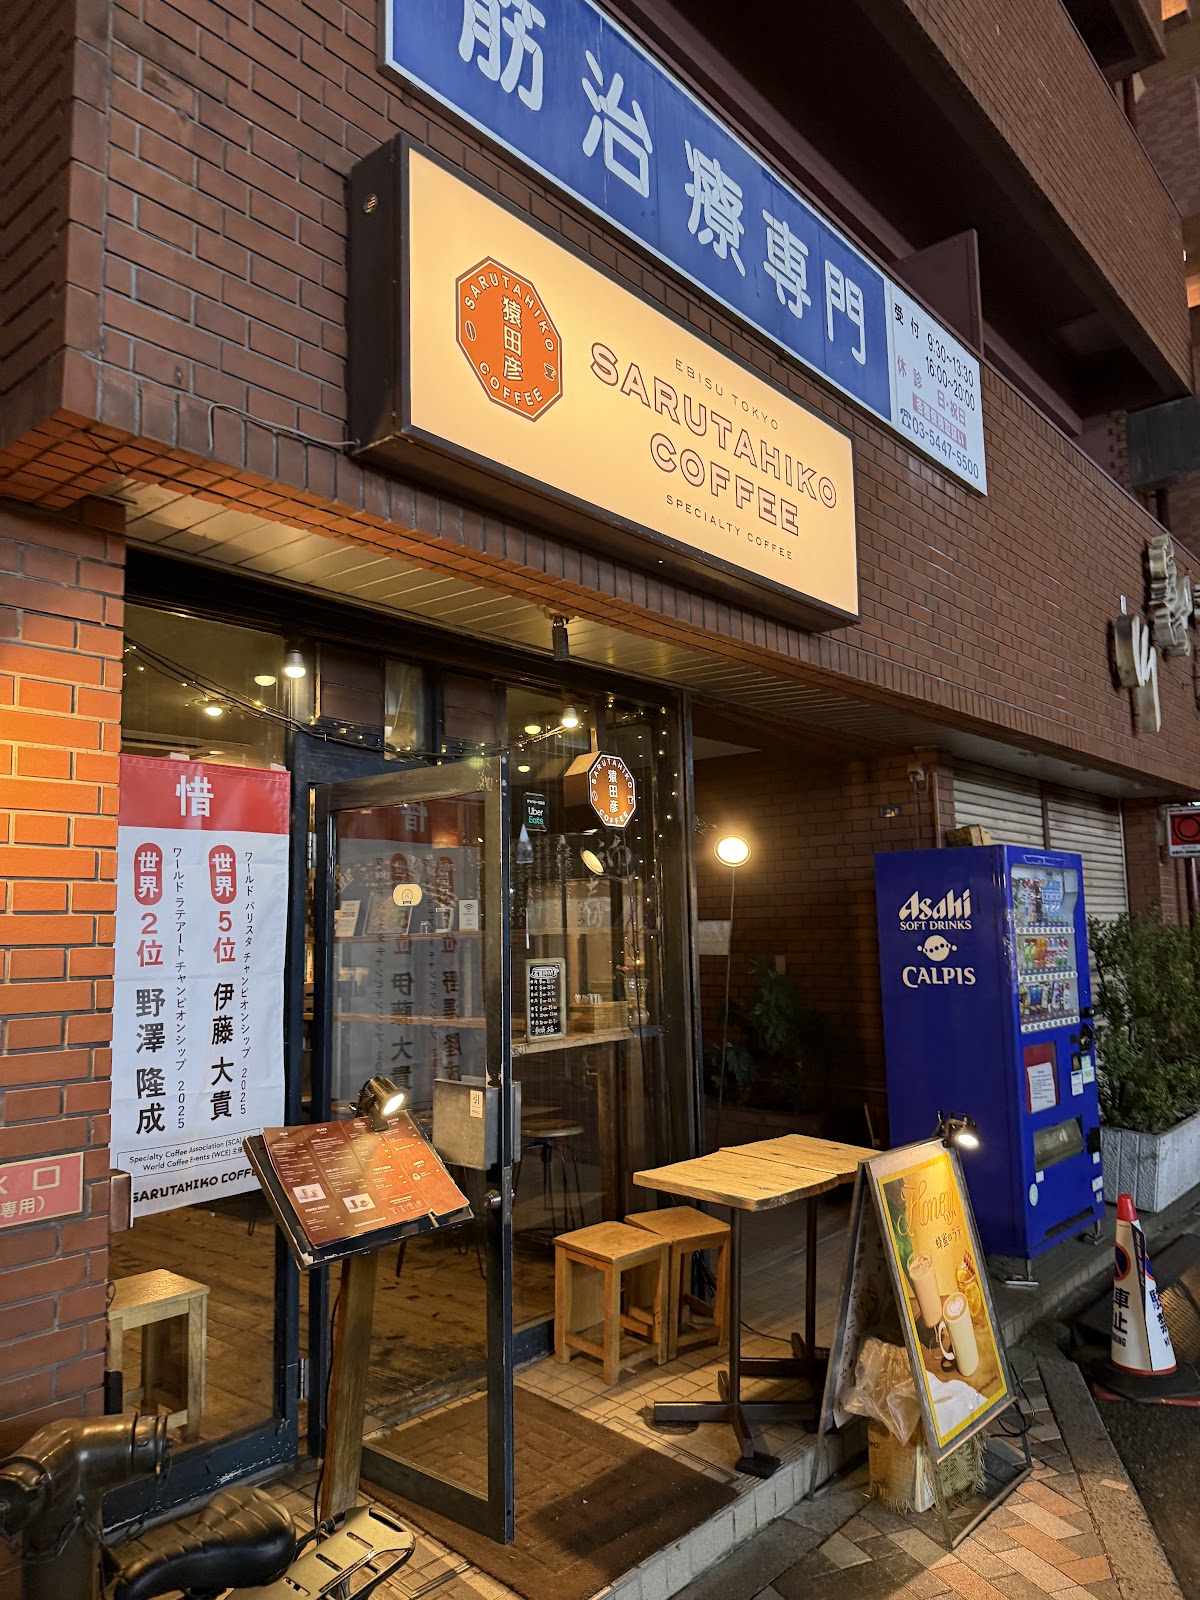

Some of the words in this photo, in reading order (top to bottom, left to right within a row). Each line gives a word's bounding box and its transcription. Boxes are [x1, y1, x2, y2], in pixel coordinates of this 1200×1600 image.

[464, 271, 555, 352] SARUTAHIKO
[894, 302, 920, 339] 受付
[501, 294, 524, 382] 猿田彦
[478, 360, 544, 407] COFFEE
[675, 358, 724, 397] EBISU
[732, 393, 779, 431] TOKYO
[897, 353, 923, 390] 休診
[590, 341, 837, 509] SARUTAHIKO
[911, 415, 979, 480] 03-5447-5500
[650, 432, 799, 537] COFFEE
[666, 494, 741, 536] SPECIALTY
[747, 532, 793, 561] COFFEE
[175, 774, 214, 818] 惜
[591, 758, 633, 789] SARUTAHIKO
[607, 769, 619, 813] 猿田彦
[528, 806, 543, 816] Uber
[528, 815, 544, 825] Eats
[598, 808, 629, 825] COFFEE
[138, 851, 160, 898] 世界
[172, 847, 185, 891] ワールド
[212, 852, 234, 898] 世界
[244, 851, 255, 897] ワールド
[174, 897, 187, 957] ラテアート
[244, 901, 255, 947] バリスタ
[899, 888, 971, 920] Asahi
[900, 921, 927, 931] SOFT
[930, 920, 972, 930] DRINKS
[136, 912, 164, 967] 2位
[212, 910, 236, 964] 5位
[902, 966, 976, 988] CALPIS
[135, 988, 166, 1053] 野澤
[175, 961, 188, 1071] チャンピオンシップ
[211, 982, 235, 1045] 伊藤
[239, 952, 252, 1059] チャンピオンシップ
[135, 1067, 167, 1135] 隆成
[177, 1080, 186, 1129] 2025
[210, 1056, 235, 1121] 大貴
[129, 1153, 164, 1164] Specialty
[165, 1149, 188, 1159] Coffee
[188, 1142, 225, 1154] Association
[142, 1161, 165, 1171] World
[166, 1158, 189, 1168] Coffee
[189, 1154, 211, 1164] Events
[211, 1148, 231, 1160] (WCE)
[133, 1175, 218, 1203] SARUTAHIKO
[898, 1180, 954, 1238] Honey
